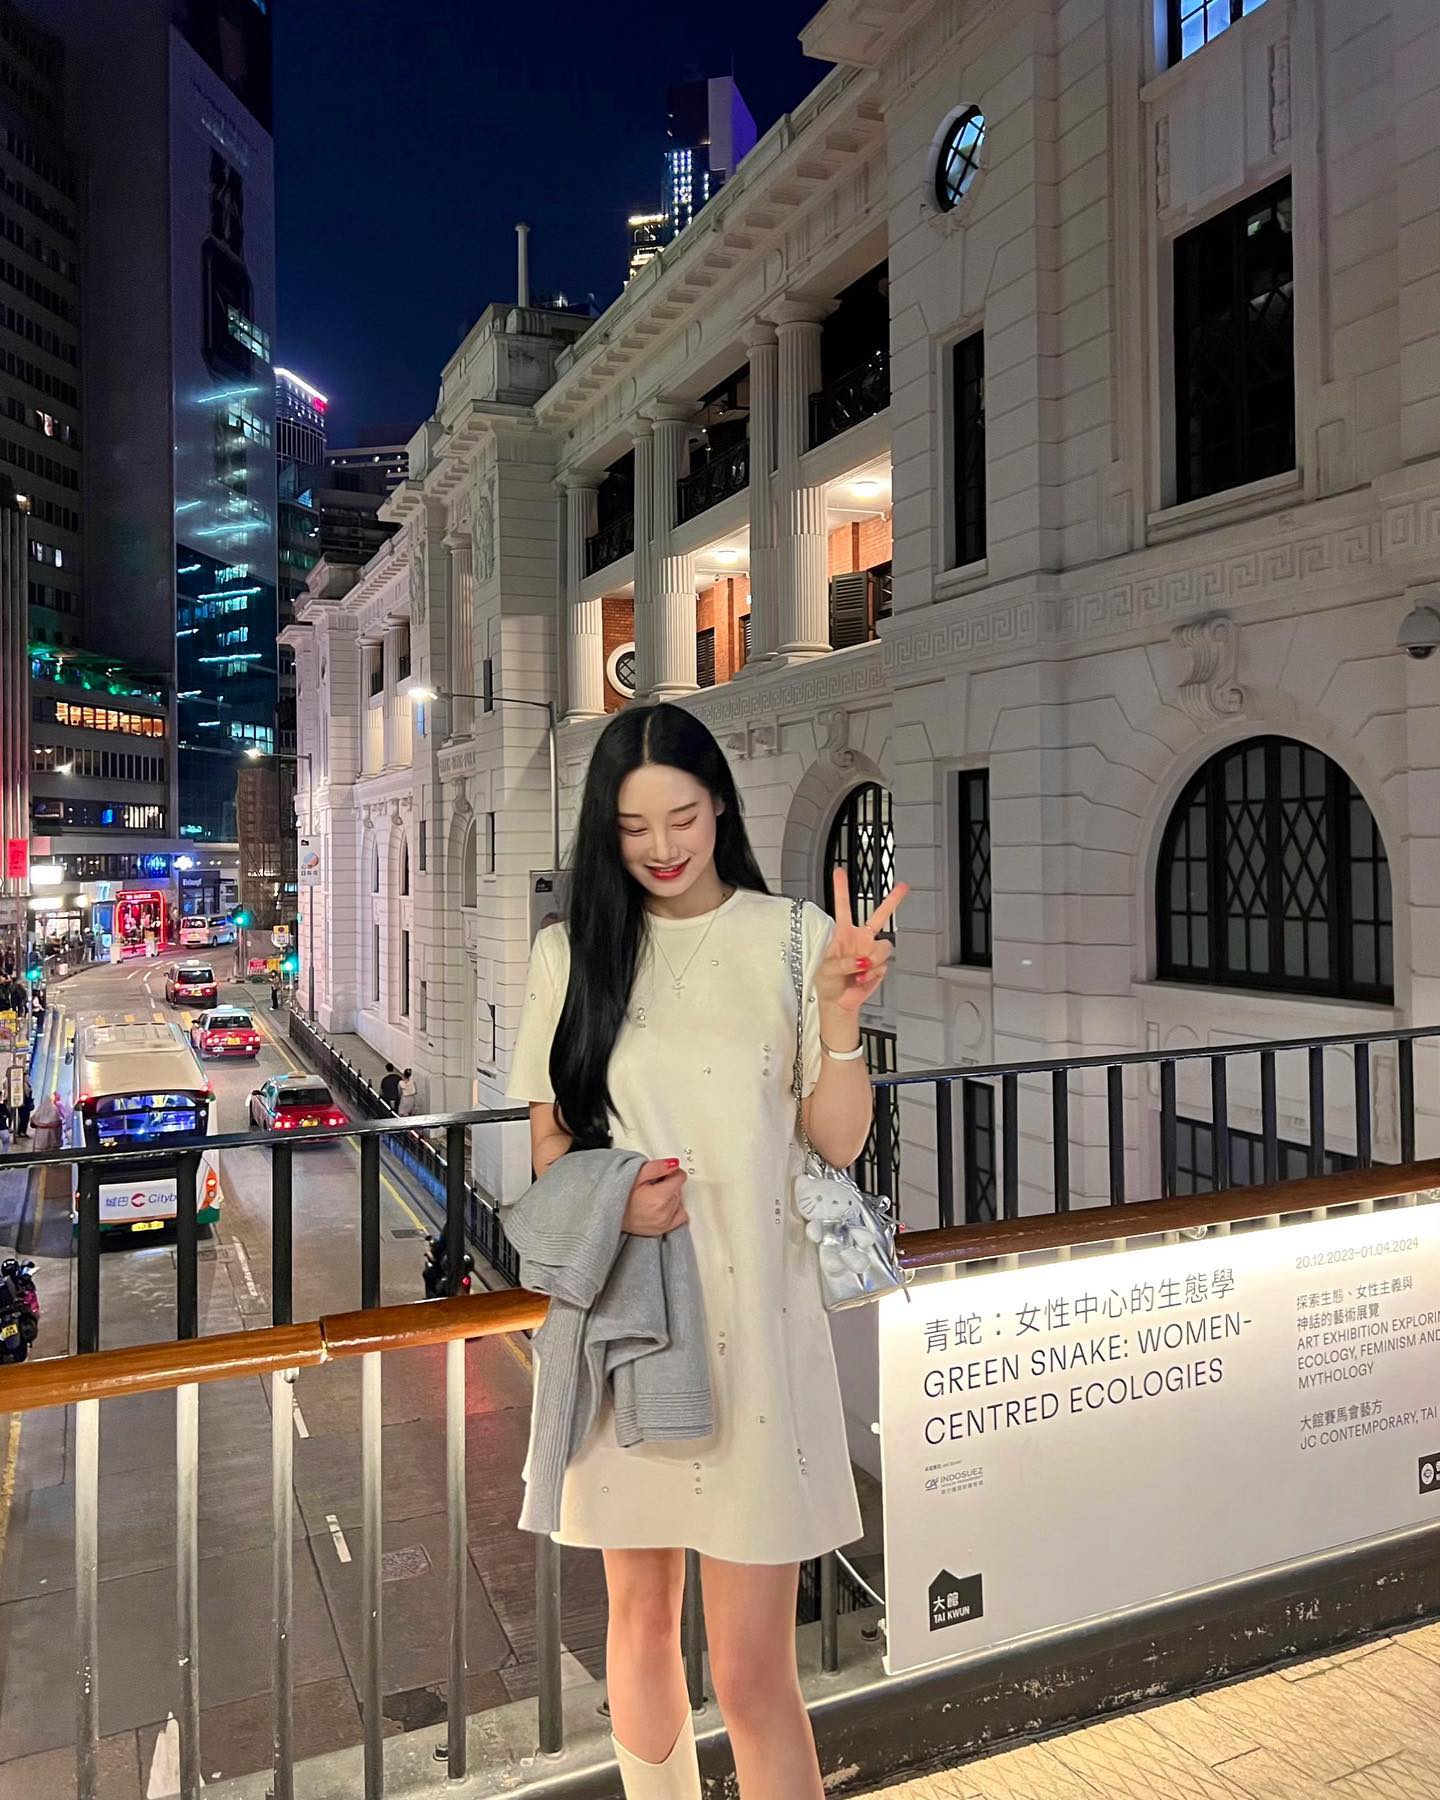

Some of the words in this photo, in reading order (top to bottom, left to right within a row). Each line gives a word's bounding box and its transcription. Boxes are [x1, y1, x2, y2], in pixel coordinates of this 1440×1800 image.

[148, 1193, 177, 1204] Cityb
[1295, 1236, 1419, 1269] 20.12.2023-01.04.2024
[923, 1268, 1235, 1355] 青蛇：女性中心的生態學
[1297, 1334, 1321, 1351] ART
[1323, 1321, 1389, 1346] EXHIBITION
[1297, 1346, 1357, 1370] ECOLOGY,
[1360, 1333, 1417, 1357] FEMINISM
[1419, 1328, 1440, 1345] AND
[924, 1354, 1019, 1398] GREEN
[1030, 1334, 1128, 1377] SNAKE:
[1137, 1311, 1252, 1354] WOMEN-
[1298, 1361, 1375, 1390] MYTHOLOGY
[924, 1392, 1059, 1445] CENTRED
[1070, 1357, 1223, 1413] ECOLOGIES
[1300, 1434, 1318, 1450] JC
[1319, 1410, 1419, 1445] CONTEMPORARY,
[1420, 1406, 1438, 1421] TAI
[933, 1591, 959, 1612] 大館
[933, 1611, 946, 1624] TAI
[947, 1605, 970, 1620] KWUN
